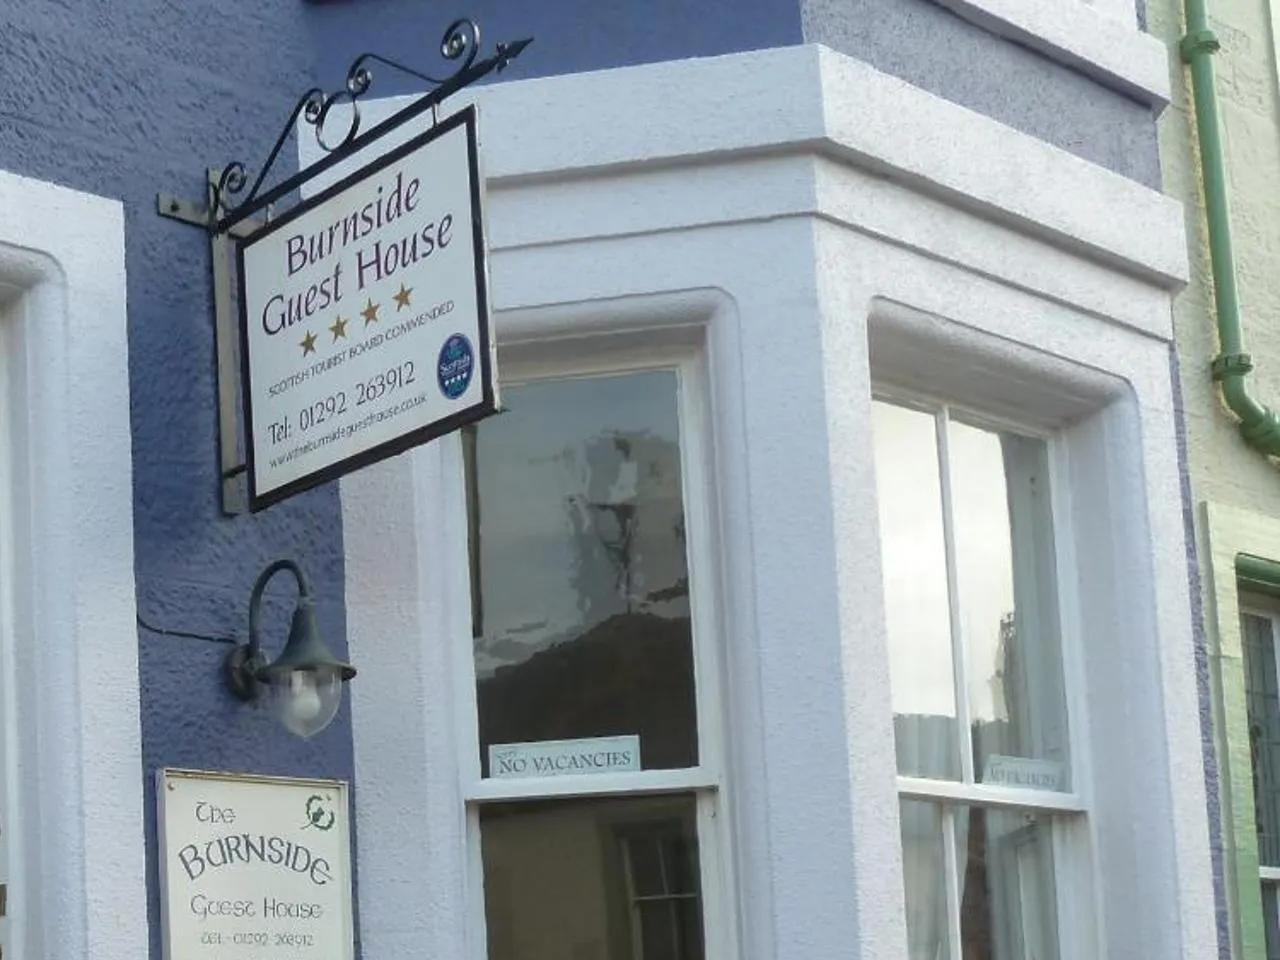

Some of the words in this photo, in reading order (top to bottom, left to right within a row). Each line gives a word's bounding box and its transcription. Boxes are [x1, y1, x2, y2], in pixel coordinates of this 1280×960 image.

[286, 171, 421, 277] Burnside
[261, 261, 344, 336] Guest
[356, 213, 454, 290] House
[268, 370, 310, 397] SCOTTISH
[309, 351, 348, 379] TOURIST
[349, 333, 384, 360] BOARD
[385, 300, 456, 341] COMMENDED
[299, 391, 348, 432] 01292
[356, 361, 416, 406] 263912
[498, 757, 527, 774] NO
[532, 751, 631, 773] VACANCIES
[195, 801, 236, 824] The
[178, 833, 334, 886] BURNSIDE
[190, 894, 256, 920] Guest
[263, 897, 323, 920] House
